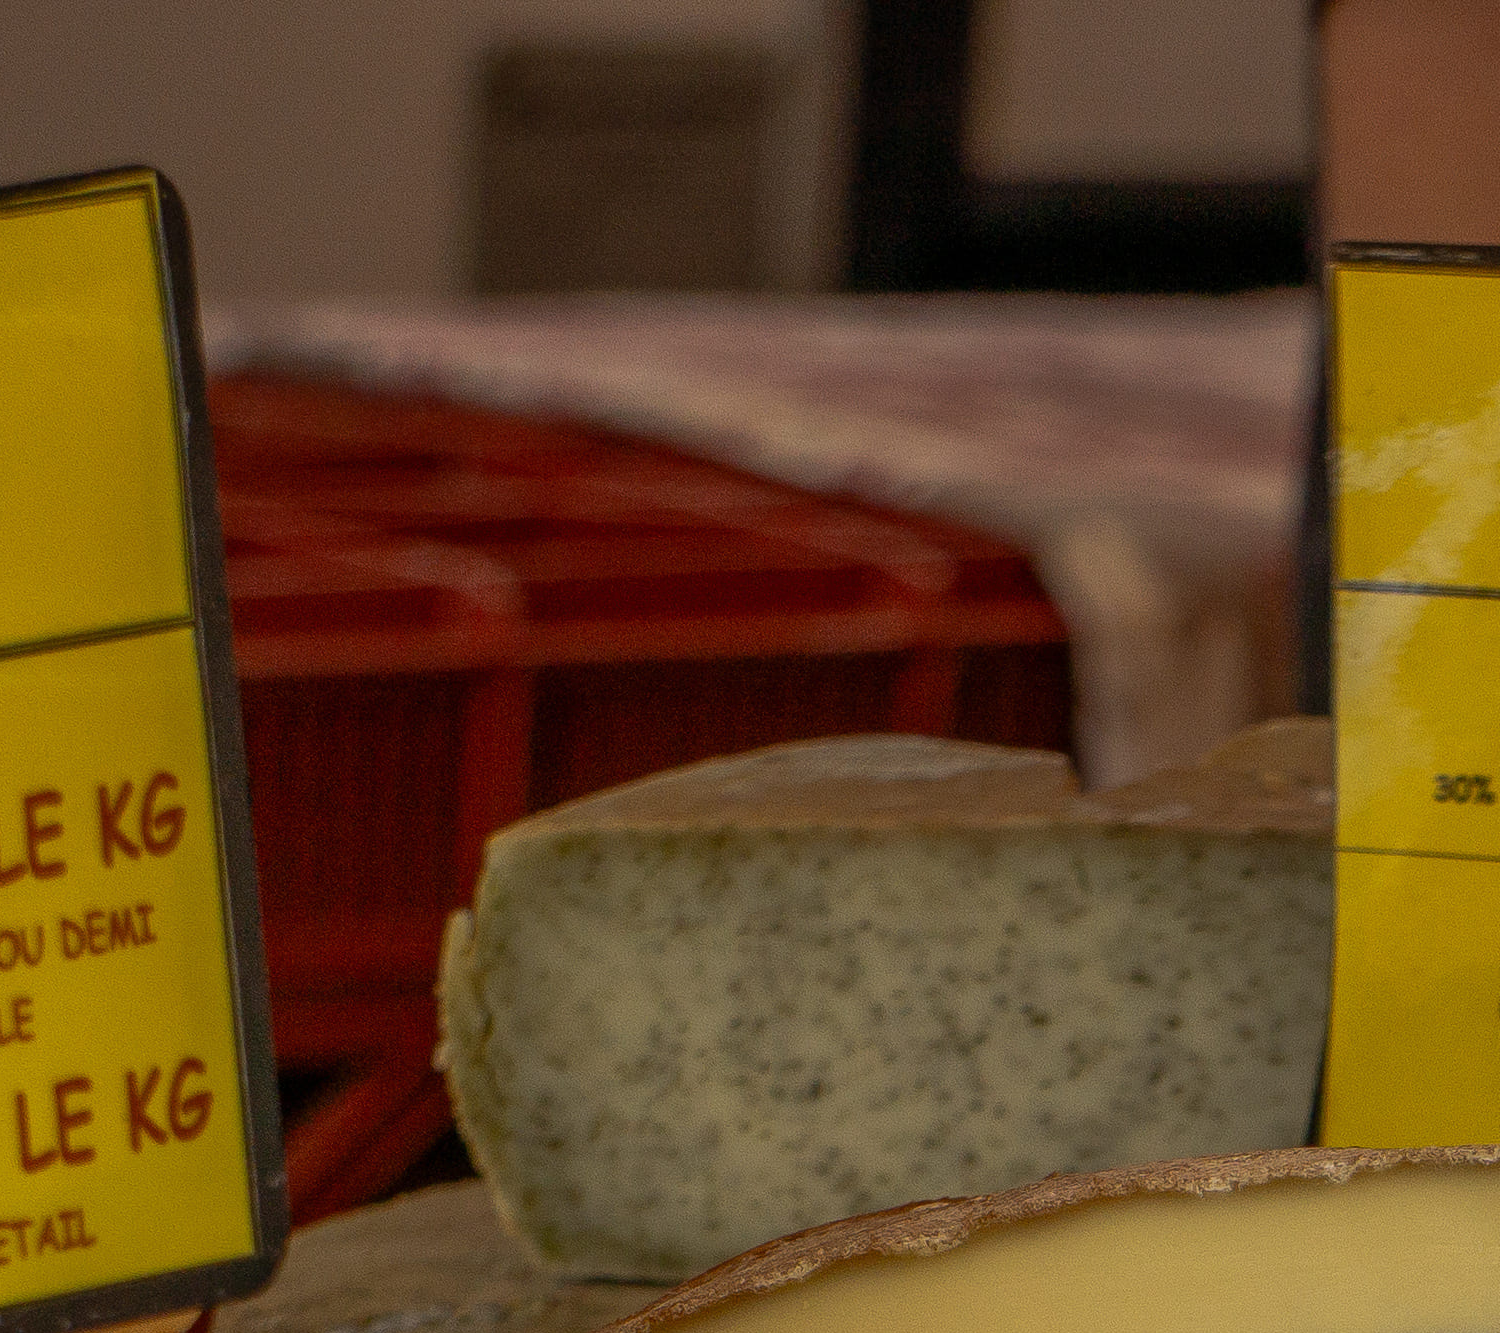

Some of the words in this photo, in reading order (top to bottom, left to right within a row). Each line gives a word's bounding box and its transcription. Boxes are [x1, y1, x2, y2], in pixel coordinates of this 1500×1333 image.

[96, 769, 187, 867] KG
[1433, 773, 1498, 807] 30%
[58, 901, 158, 961] DEMI
[13, 1074, 97, 1175] LE
[124, 1055, 214, 1153] KG
